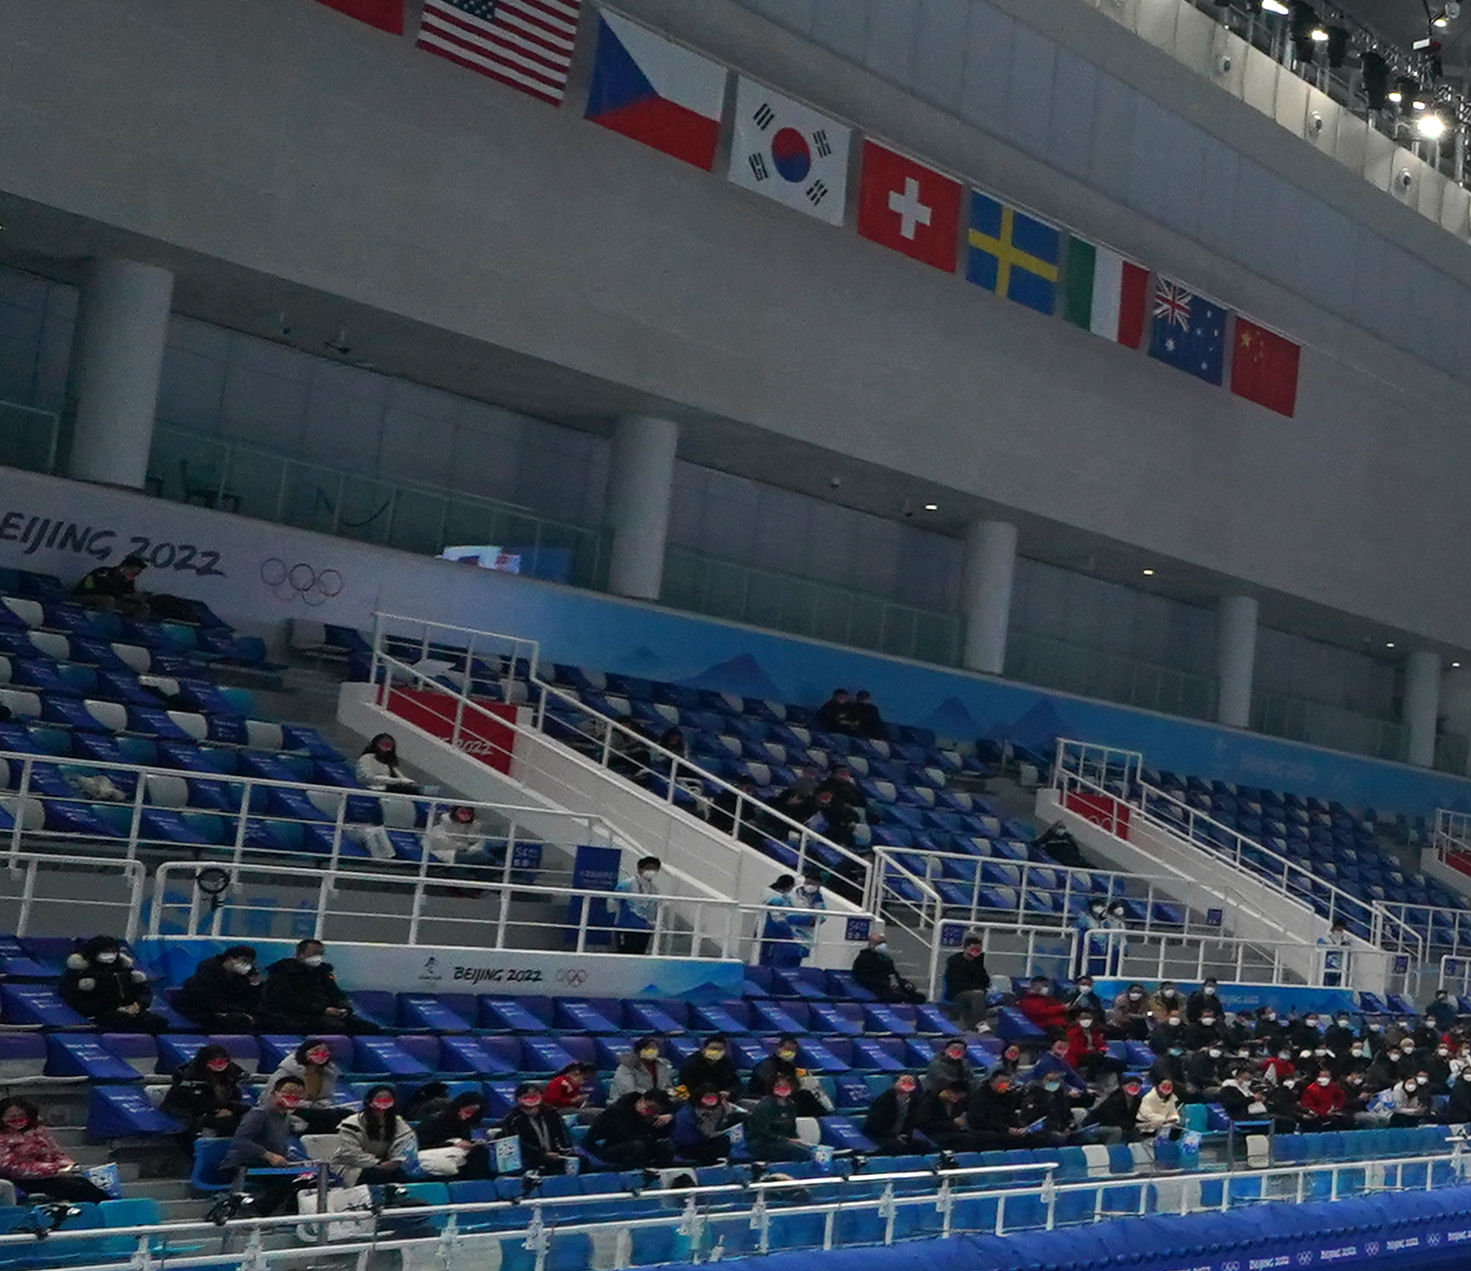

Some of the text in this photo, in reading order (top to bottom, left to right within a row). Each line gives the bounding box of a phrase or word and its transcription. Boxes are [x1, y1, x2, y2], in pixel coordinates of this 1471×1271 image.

[0, 511, 226, 578] EIJING 2022
[453, 965, 543, 984] BEIJING 2022
